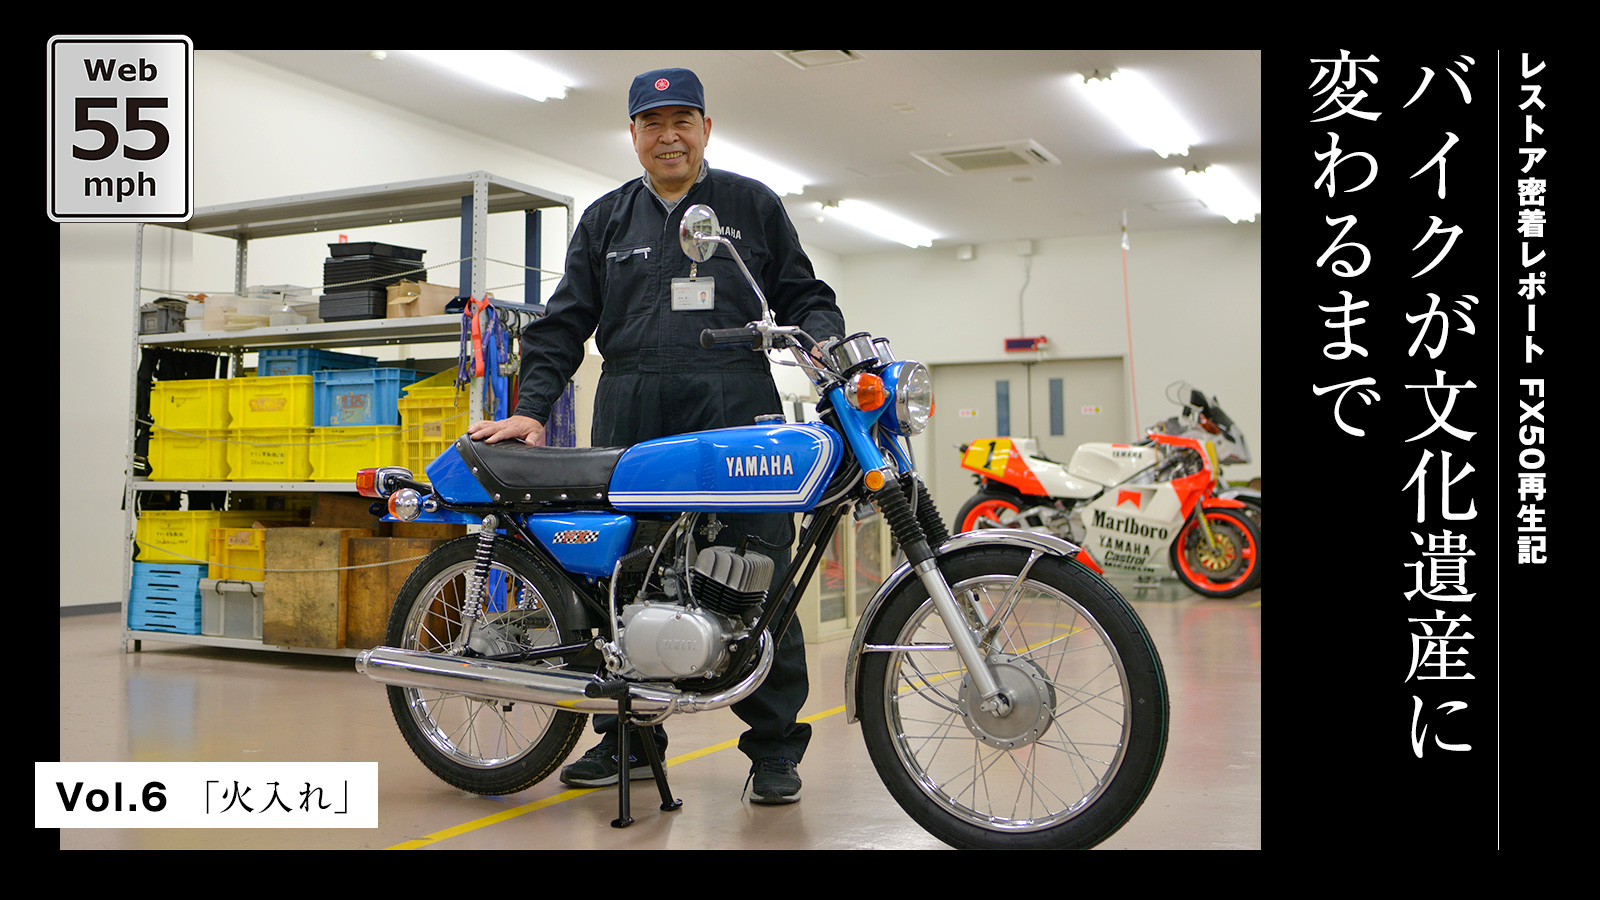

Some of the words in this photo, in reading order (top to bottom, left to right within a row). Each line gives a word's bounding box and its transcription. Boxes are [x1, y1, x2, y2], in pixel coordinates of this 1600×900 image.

[720, 226, 742, 240] MAHA
[726, 454, 794, 477] YAMAHA
[983, 441, 996, 470] 1
[1092, 508, 1168, 541] Marlboro
[1099, 535, 1150, 556] YAMAHA
[1104, 550, 1146, 566] Castrol
